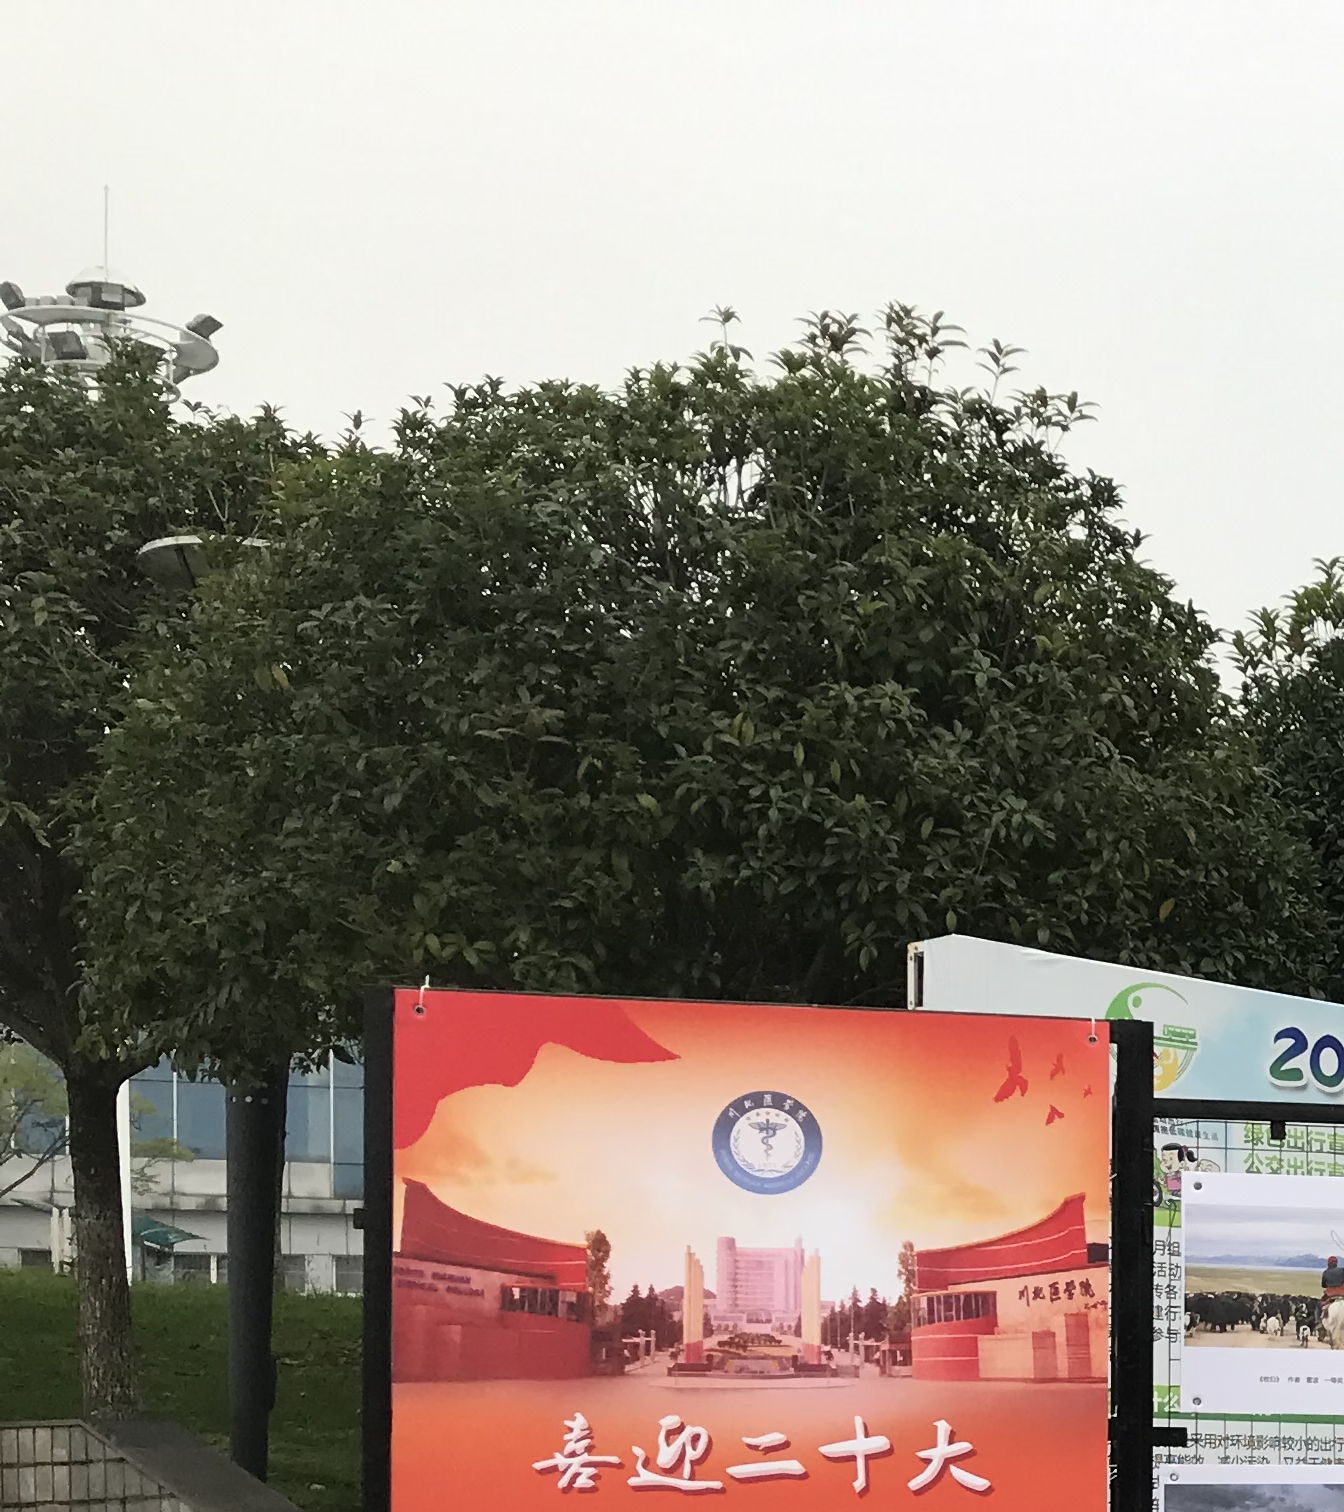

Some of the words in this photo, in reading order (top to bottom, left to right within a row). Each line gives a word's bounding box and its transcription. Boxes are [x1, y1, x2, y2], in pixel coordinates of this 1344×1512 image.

[532, 1413, 993, 1494] 喜迎二十大
